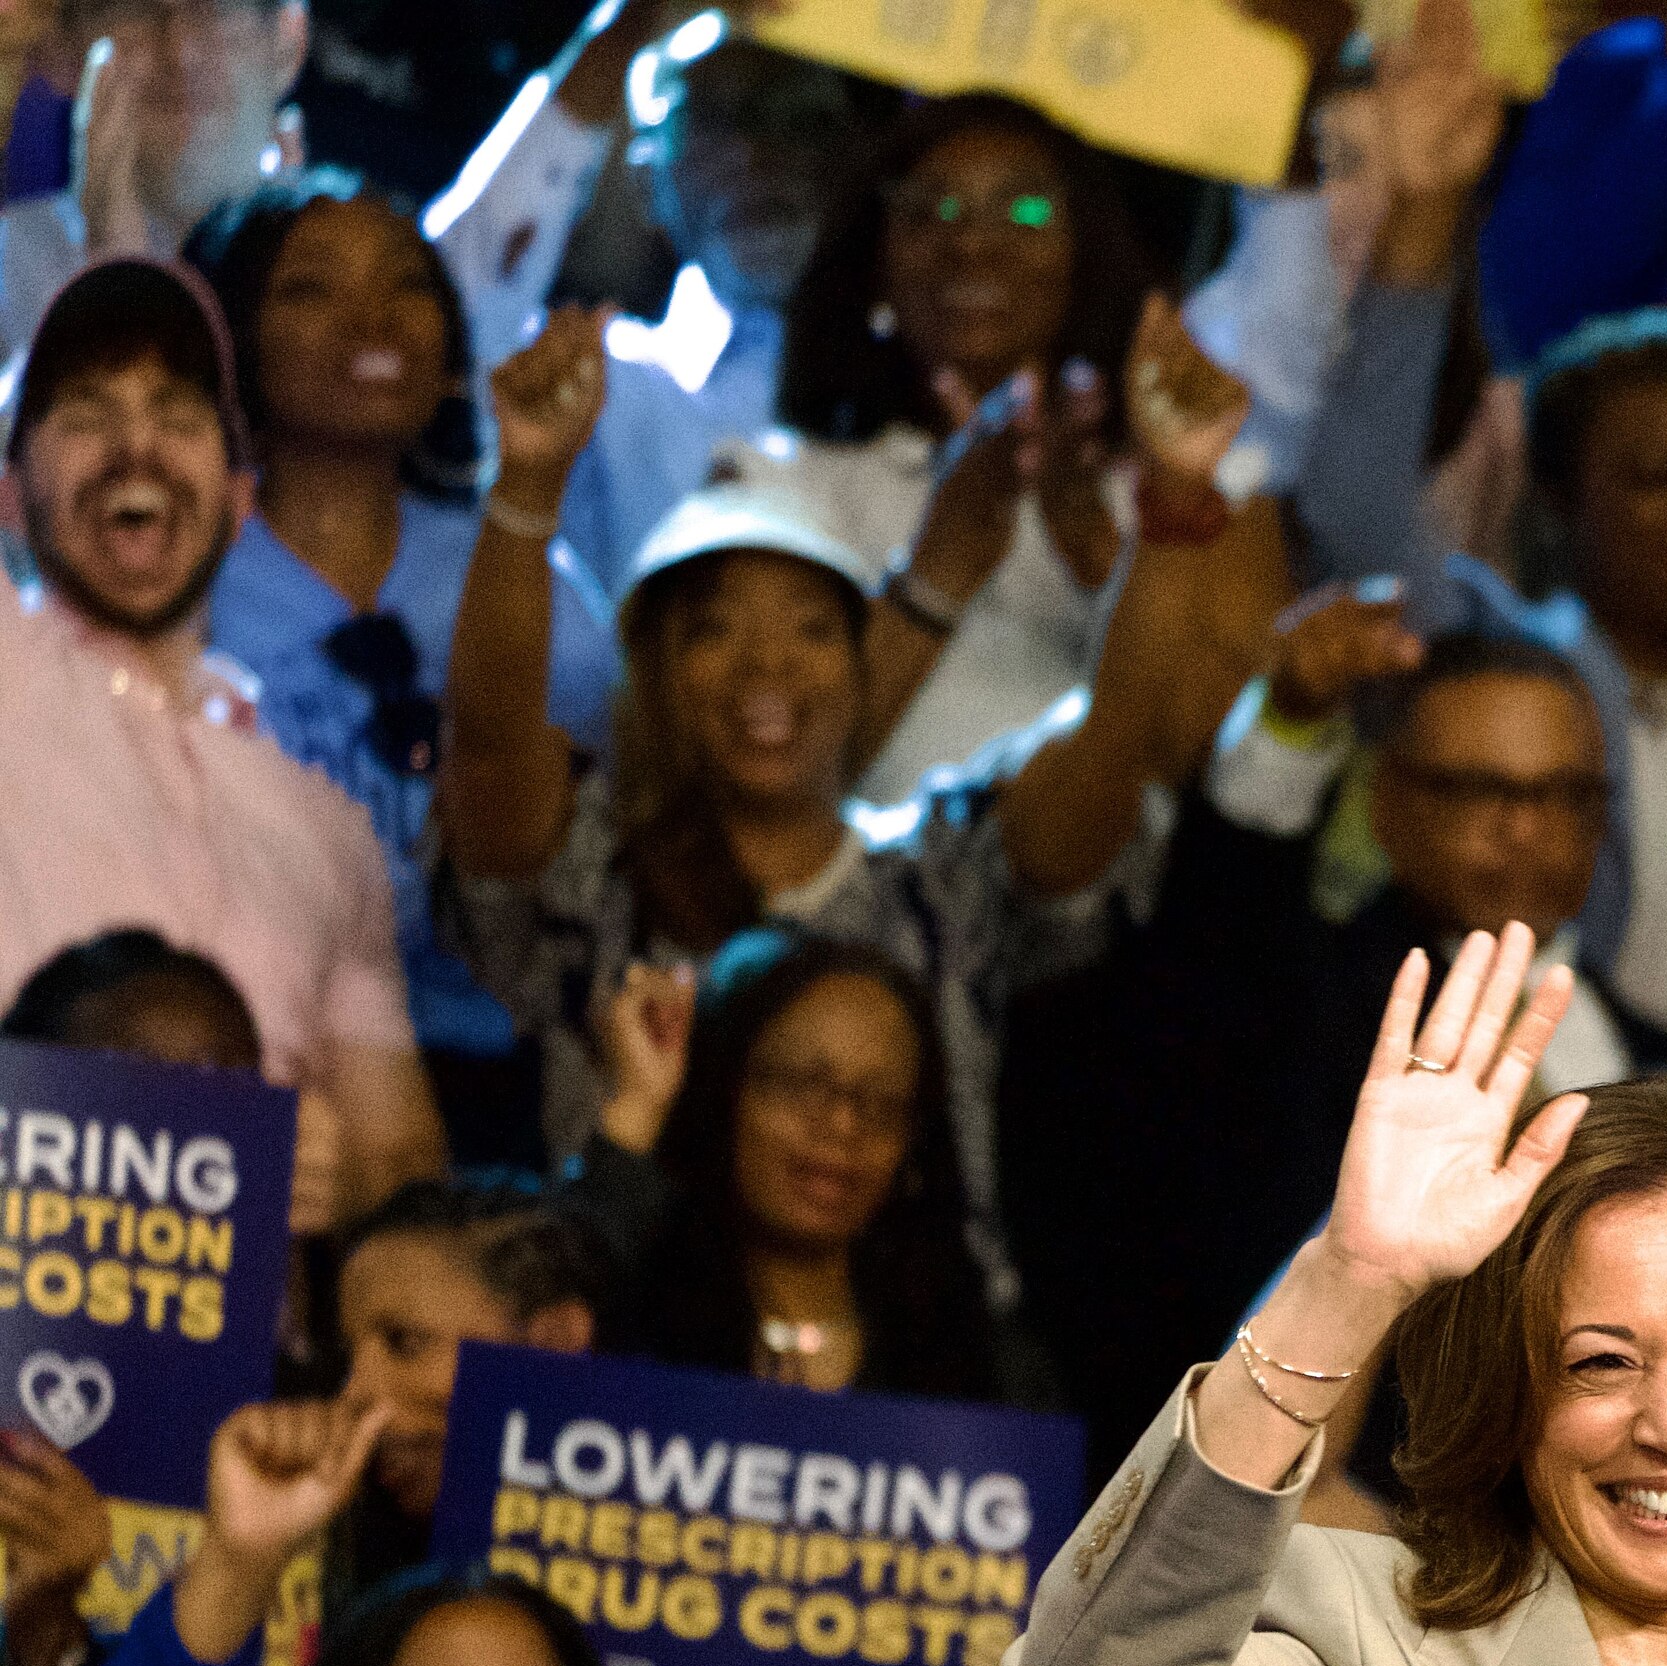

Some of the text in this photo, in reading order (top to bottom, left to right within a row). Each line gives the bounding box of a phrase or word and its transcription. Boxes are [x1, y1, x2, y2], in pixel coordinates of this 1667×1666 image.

[0, 1110, 239, 1213] RING
[500, 1408, 1031, 1552] LOWERING
[493, 1487, 1029, 1608] PRESCRIPTION
